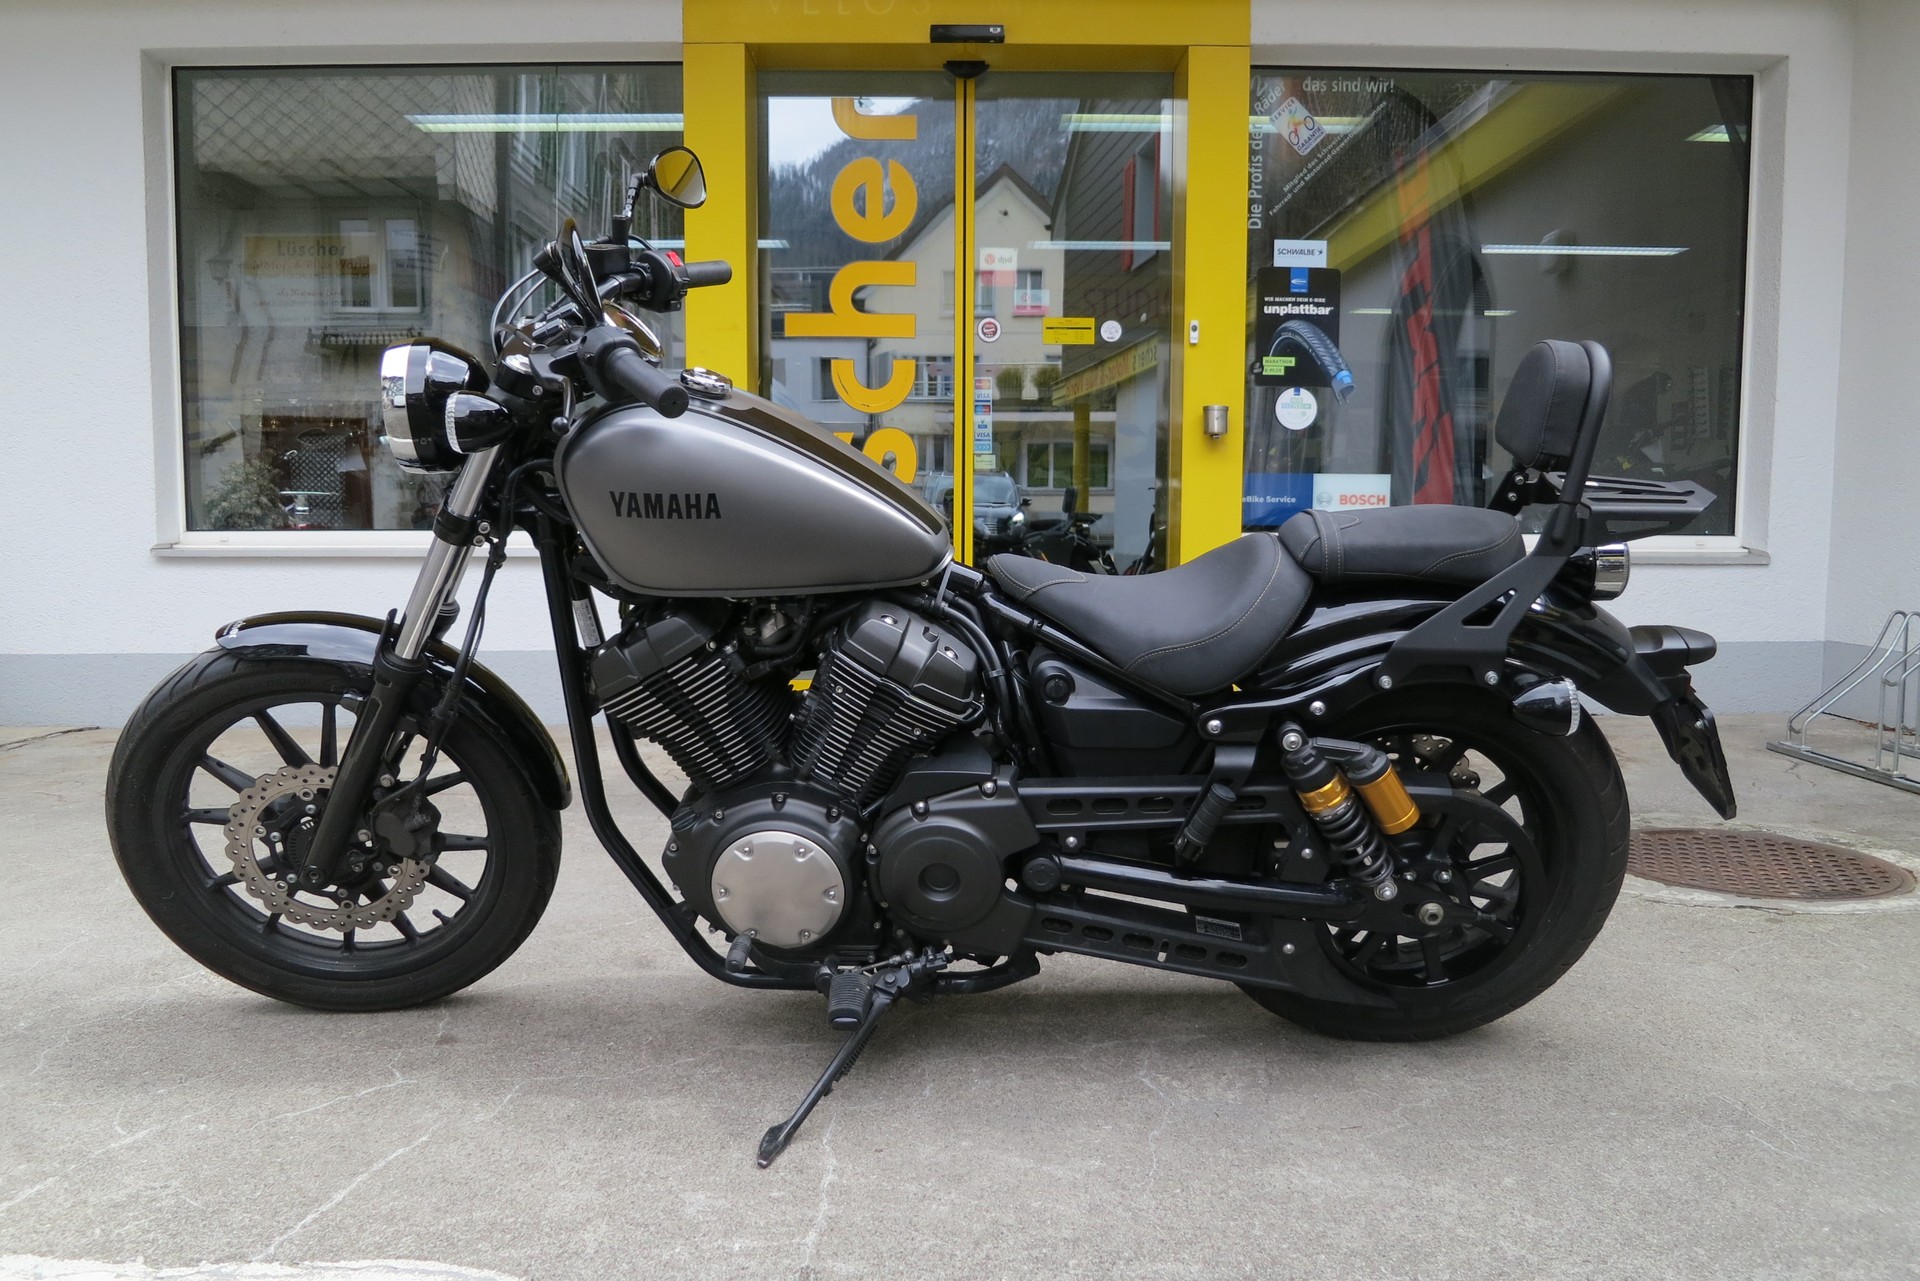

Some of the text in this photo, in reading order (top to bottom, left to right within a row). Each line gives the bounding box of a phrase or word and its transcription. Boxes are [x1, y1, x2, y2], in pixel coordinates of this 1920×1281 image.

[1302, 76, 1395, 93] das sind wir!
[1247, 123, 1264, 230] Die Profis der
[1283, 167, 1308, 193] Mitglied
[1268, 193, 1293, 217] Fahrrad-
[998, 255, 1013, 265] dpd
[1276, 248, 1316, 256] SCHWALBE
[1263, 304, 1331, 316] unplattbar
[609, 490, 722, 519] YAMAHA
[1339, 494, 1387, 506] BOSCH
